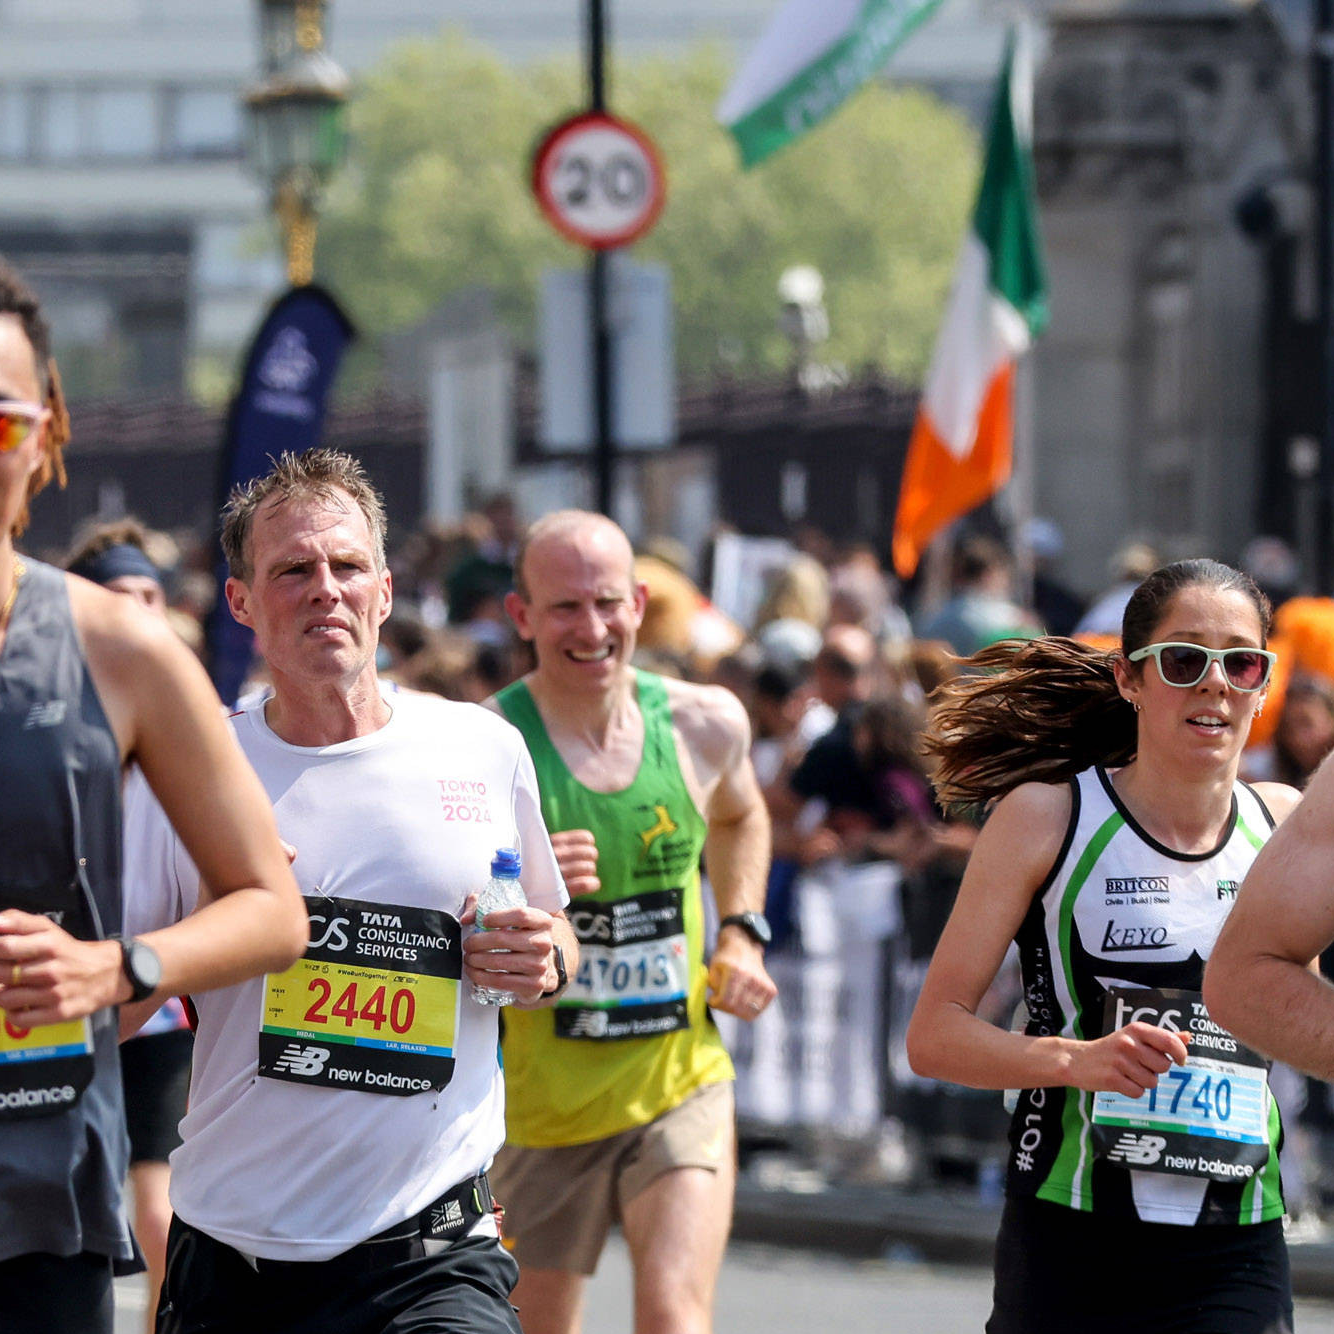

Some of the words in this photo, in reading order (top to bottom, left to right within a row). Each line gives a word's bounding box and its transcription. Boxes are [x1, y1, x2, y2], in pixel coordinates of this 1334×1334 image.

[560, 152, 648, 209] 20
[436, 780, 486, 796] TOKYO
[442, 804, 492, 824] 2024
[1106, 878, 1170, 893] BRITCON
[360, 911, 402, 929] TATA
[307, 914, 351, 952] cs
[358, 927, 452, 951] CONSULTANCY
[355, 942, 418, 962] SERVICES
[303, 977, 416, 1035] 2440
[1187, 1032, 1237, 1053] SERVICES
[328, 1066, 363, 1083] new
[364, 1069, 432, 1091] balance
[1165, 1155, 1196, 1171] new
[1198, 1159, 1255, 1178] balance
[432, 1217, 465, 1235] karrimor
